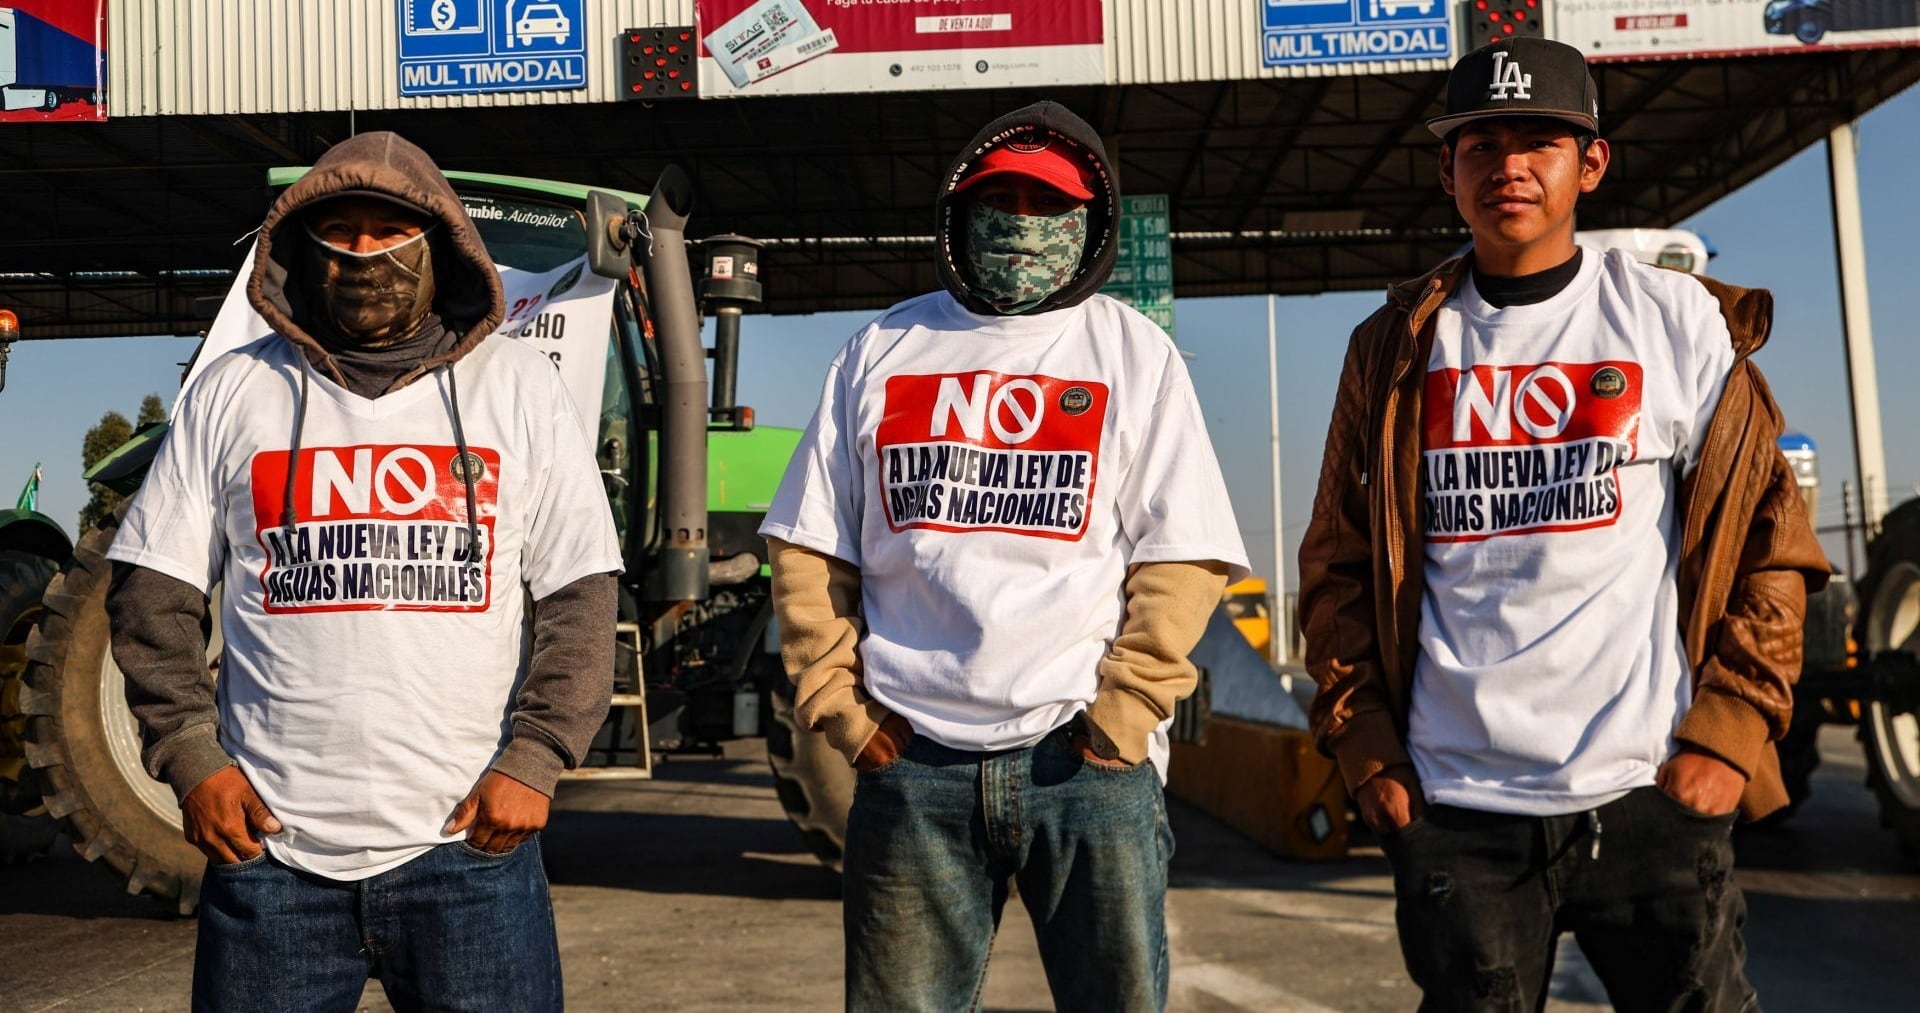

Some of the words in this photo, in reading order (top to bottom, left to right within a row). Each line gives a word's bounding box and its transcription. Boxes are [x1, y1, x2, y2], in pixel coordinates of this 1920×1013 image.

[1269, 29, 1446, 58] MULTIMODAL
[404, 60, 581, 87] MULTIMODAL
[1489, 51, 1532, 100] LA
[508, 209, 568, 229] Autopilot
[930, 373, 1045, 445] NO
[1452, 365, 1577, 442] NO
[311, 447, 437, 517] NO
[890, 448, 903, 483] A
[907, 447, 932, 482] LA
[931, 445, 1008, 490] NUEVA
[1013, 454, 1054, 490] LEY
[1055, 454, 1088, 490] DE
[1434, 453, 1459, 490] LA
[1465, 448, 1549, 490] NUEVA
[1553, 442, 1591, 483] LEY
[946, 486, 1085, 530] NACIONALES
[1490, 476, 1618, 530] NACIONALES
[268, 531, 287, 567] A
[284, 527, 312, 565] LA
[318, 524, 401, 560] NUEVA
[407, 525, 448, 560] LEY
[268, 564, 337, 604] AGUAS
[342, 563, 483, 603] NACIONALES
